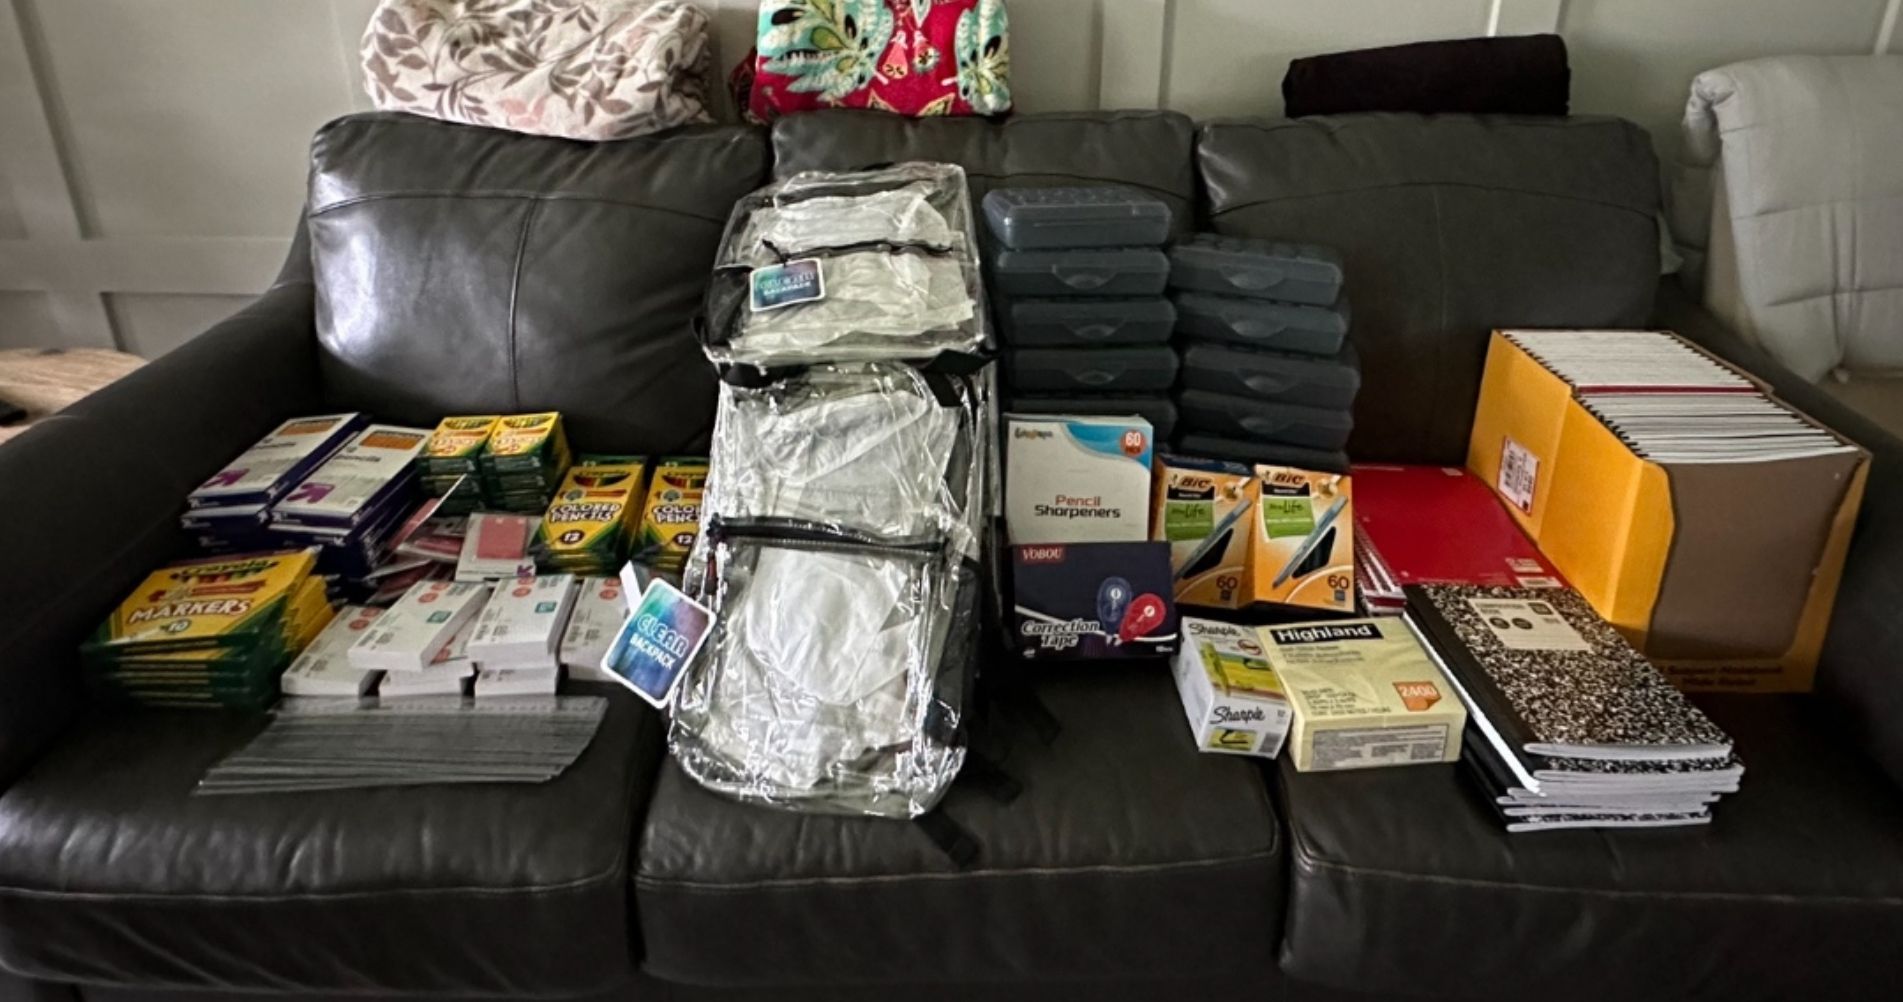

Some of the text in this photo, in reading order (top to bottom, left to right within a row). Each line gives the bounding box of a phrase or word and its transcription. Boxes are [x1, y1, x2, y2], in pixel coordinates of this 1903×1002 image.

[1125, 431, 1141, 446] 60
[1055, 494, 1102, 506] Pencil
[551, 503, 622, 514] COLORED
[653, 504, 700, 514] COLO
[1034, 504, 1121, 520] Sharpeners
[551, 510, 613, 523] PENCILS
[655, 512, 700, 524] PENC
[563, 531, 581, 543] 12
[677, 534, 695, 545] 12
[1216, 576, 1238, 590] 60
[1327, 575, 1349, 590] 60
[128, 600, 251, 624] MARKERS
[166, 619, 189, 632] 10
[1021, 618, 1100, 636] Correction
[637, 613, 690, 659] CLEAR
[1277, 624, 1373, 642] Highland
[1041, 634, 1079, 651] Tape
[630, 632, 677, 670] BACKPACK
[1398, 685, 1437, 698] 2400
[1209, 705, 1265, 725] Sharpie
